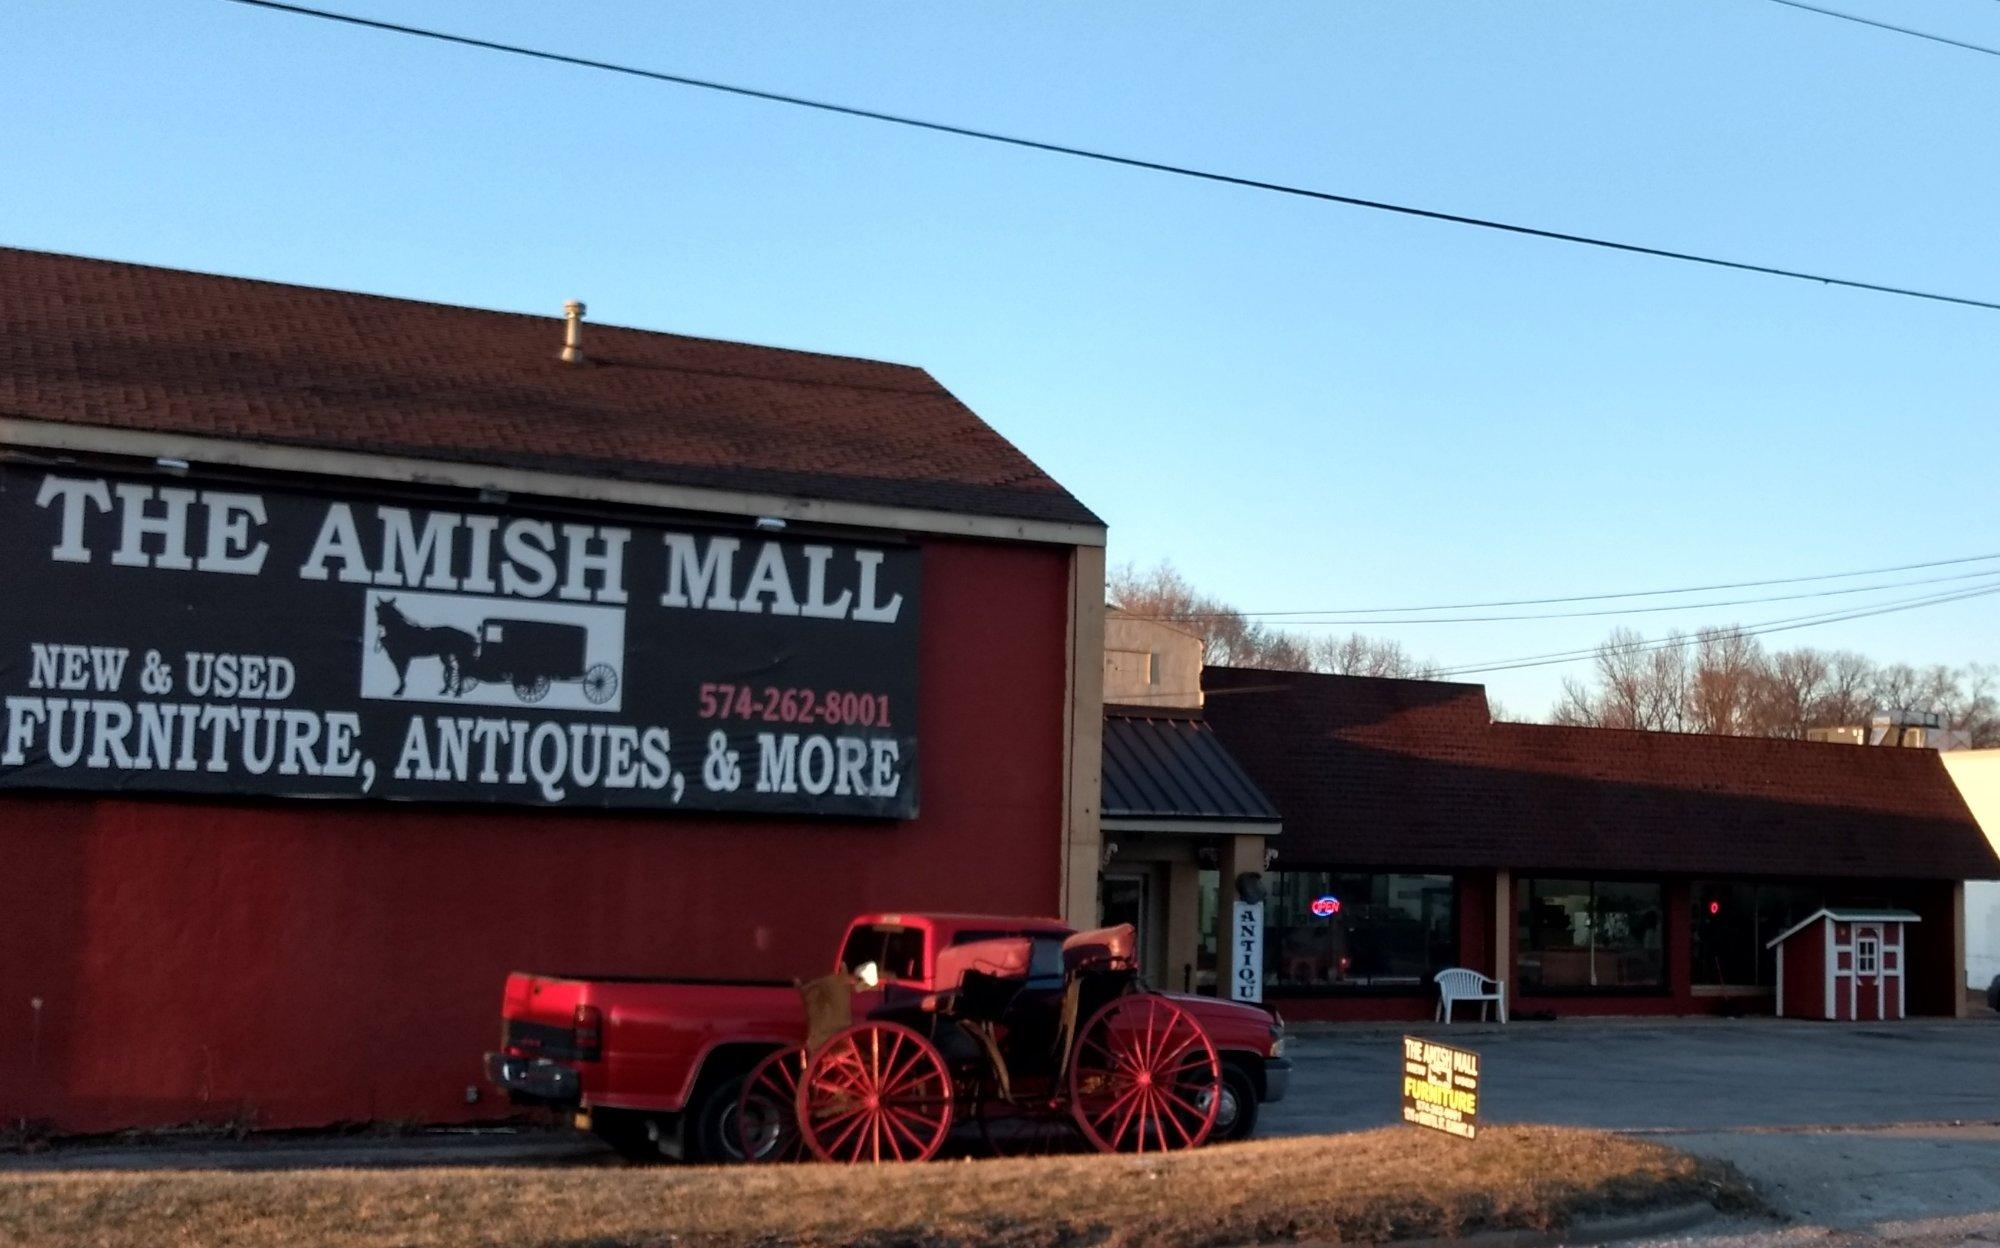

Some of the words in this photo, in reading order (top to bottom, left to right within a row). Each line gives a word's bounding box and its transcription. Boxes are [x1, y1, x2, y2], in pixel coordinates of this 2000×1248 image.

[35, 474, 270, 576] THE
[300, 502, 632, 604] AMISH
[660, 532, 903, 624] MALL
[29, 643, 129, 692] NEW
[140, 649, 173, 695] &
[186, 652, 296, 700] USED
[699, 683, 891, 728] 574-262-8001
[1, 696, 376, 794] FURNITURE,
[394, 715, 685, 804] ANTIQUES,
[703, 729, 741, 793] &
[756, 732, 900, 798] MORE
[1311, 899, 1340, 914] OPEN
[1404, 1039, 1423, 1062] THE
[1423, 1044, 1453, 1070] AMISH
[1453, 1051, 1478, 1076] MALL
[1404, 1076, 1477, 1115] FURNITURE
